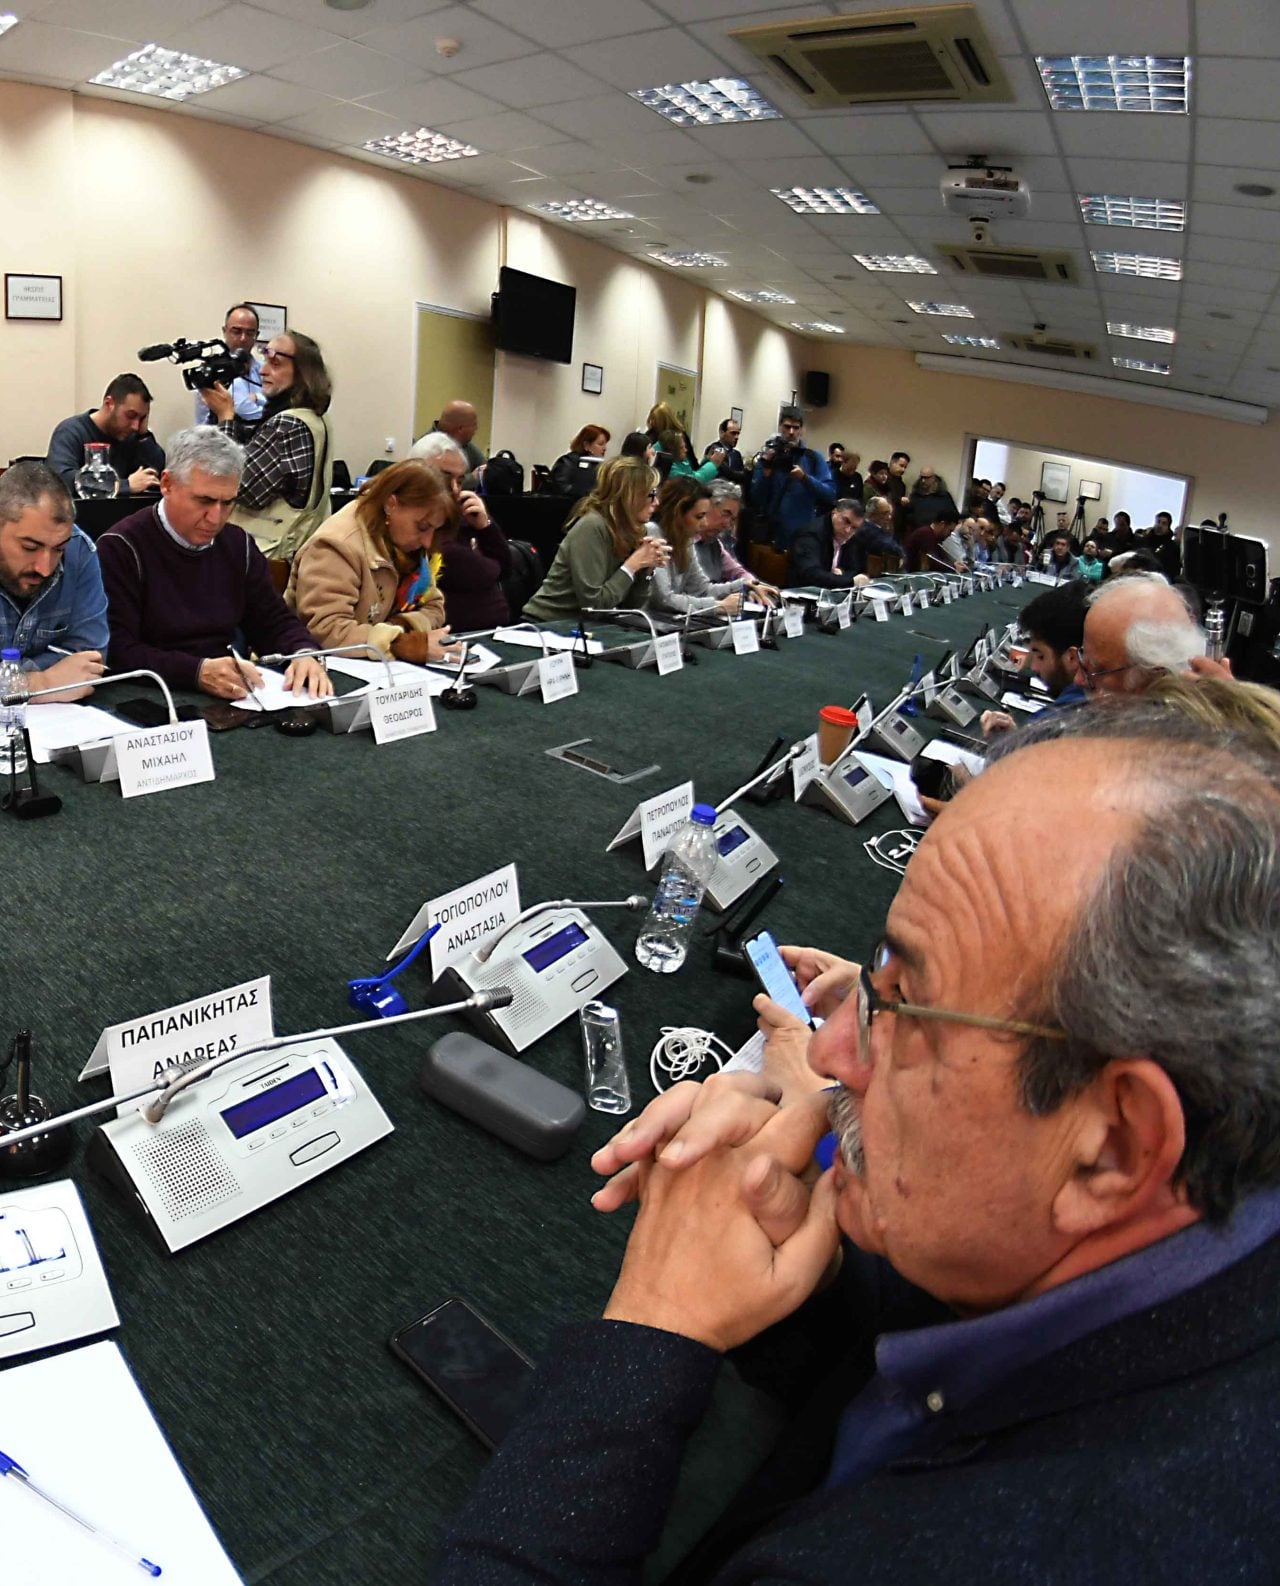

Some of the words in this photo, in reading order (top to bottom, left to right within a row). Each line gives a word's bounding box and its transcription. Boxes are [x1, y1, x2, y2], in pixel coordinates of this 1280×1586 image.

[375, 687, 423, 706] ΤΟΥΛΓΑΡΙΔΗΣ
[383, 707, 423, 724] ΘΕΟΔΩΡΟΣ
[126, 729, 194, 751] ΑΝΑΣΤΑΣΙΟΥ
[141, 752, 187, 770] ΜΙΧΑΗΛ
[136, 769, 198, 788] ΑΝΤΙΔΗΜΑΡΧΟΣ
[646, 795, 689, 823] ΠΕΤΡΟΠΟΥΛΟΣ
[652, 816, 688, 843] ΠΑΝΑΓΙΩΤΗ
[433, 879, 509, 927] ΤΟΓΙΟΠΟΥΛΟΥ
[447, 911, 506, 953] ΑΝΑΣΤΑΣΙΑ
[120, 988, 259, 1049] ΠΑΠΑΝΙΚΗΤΑΣ
